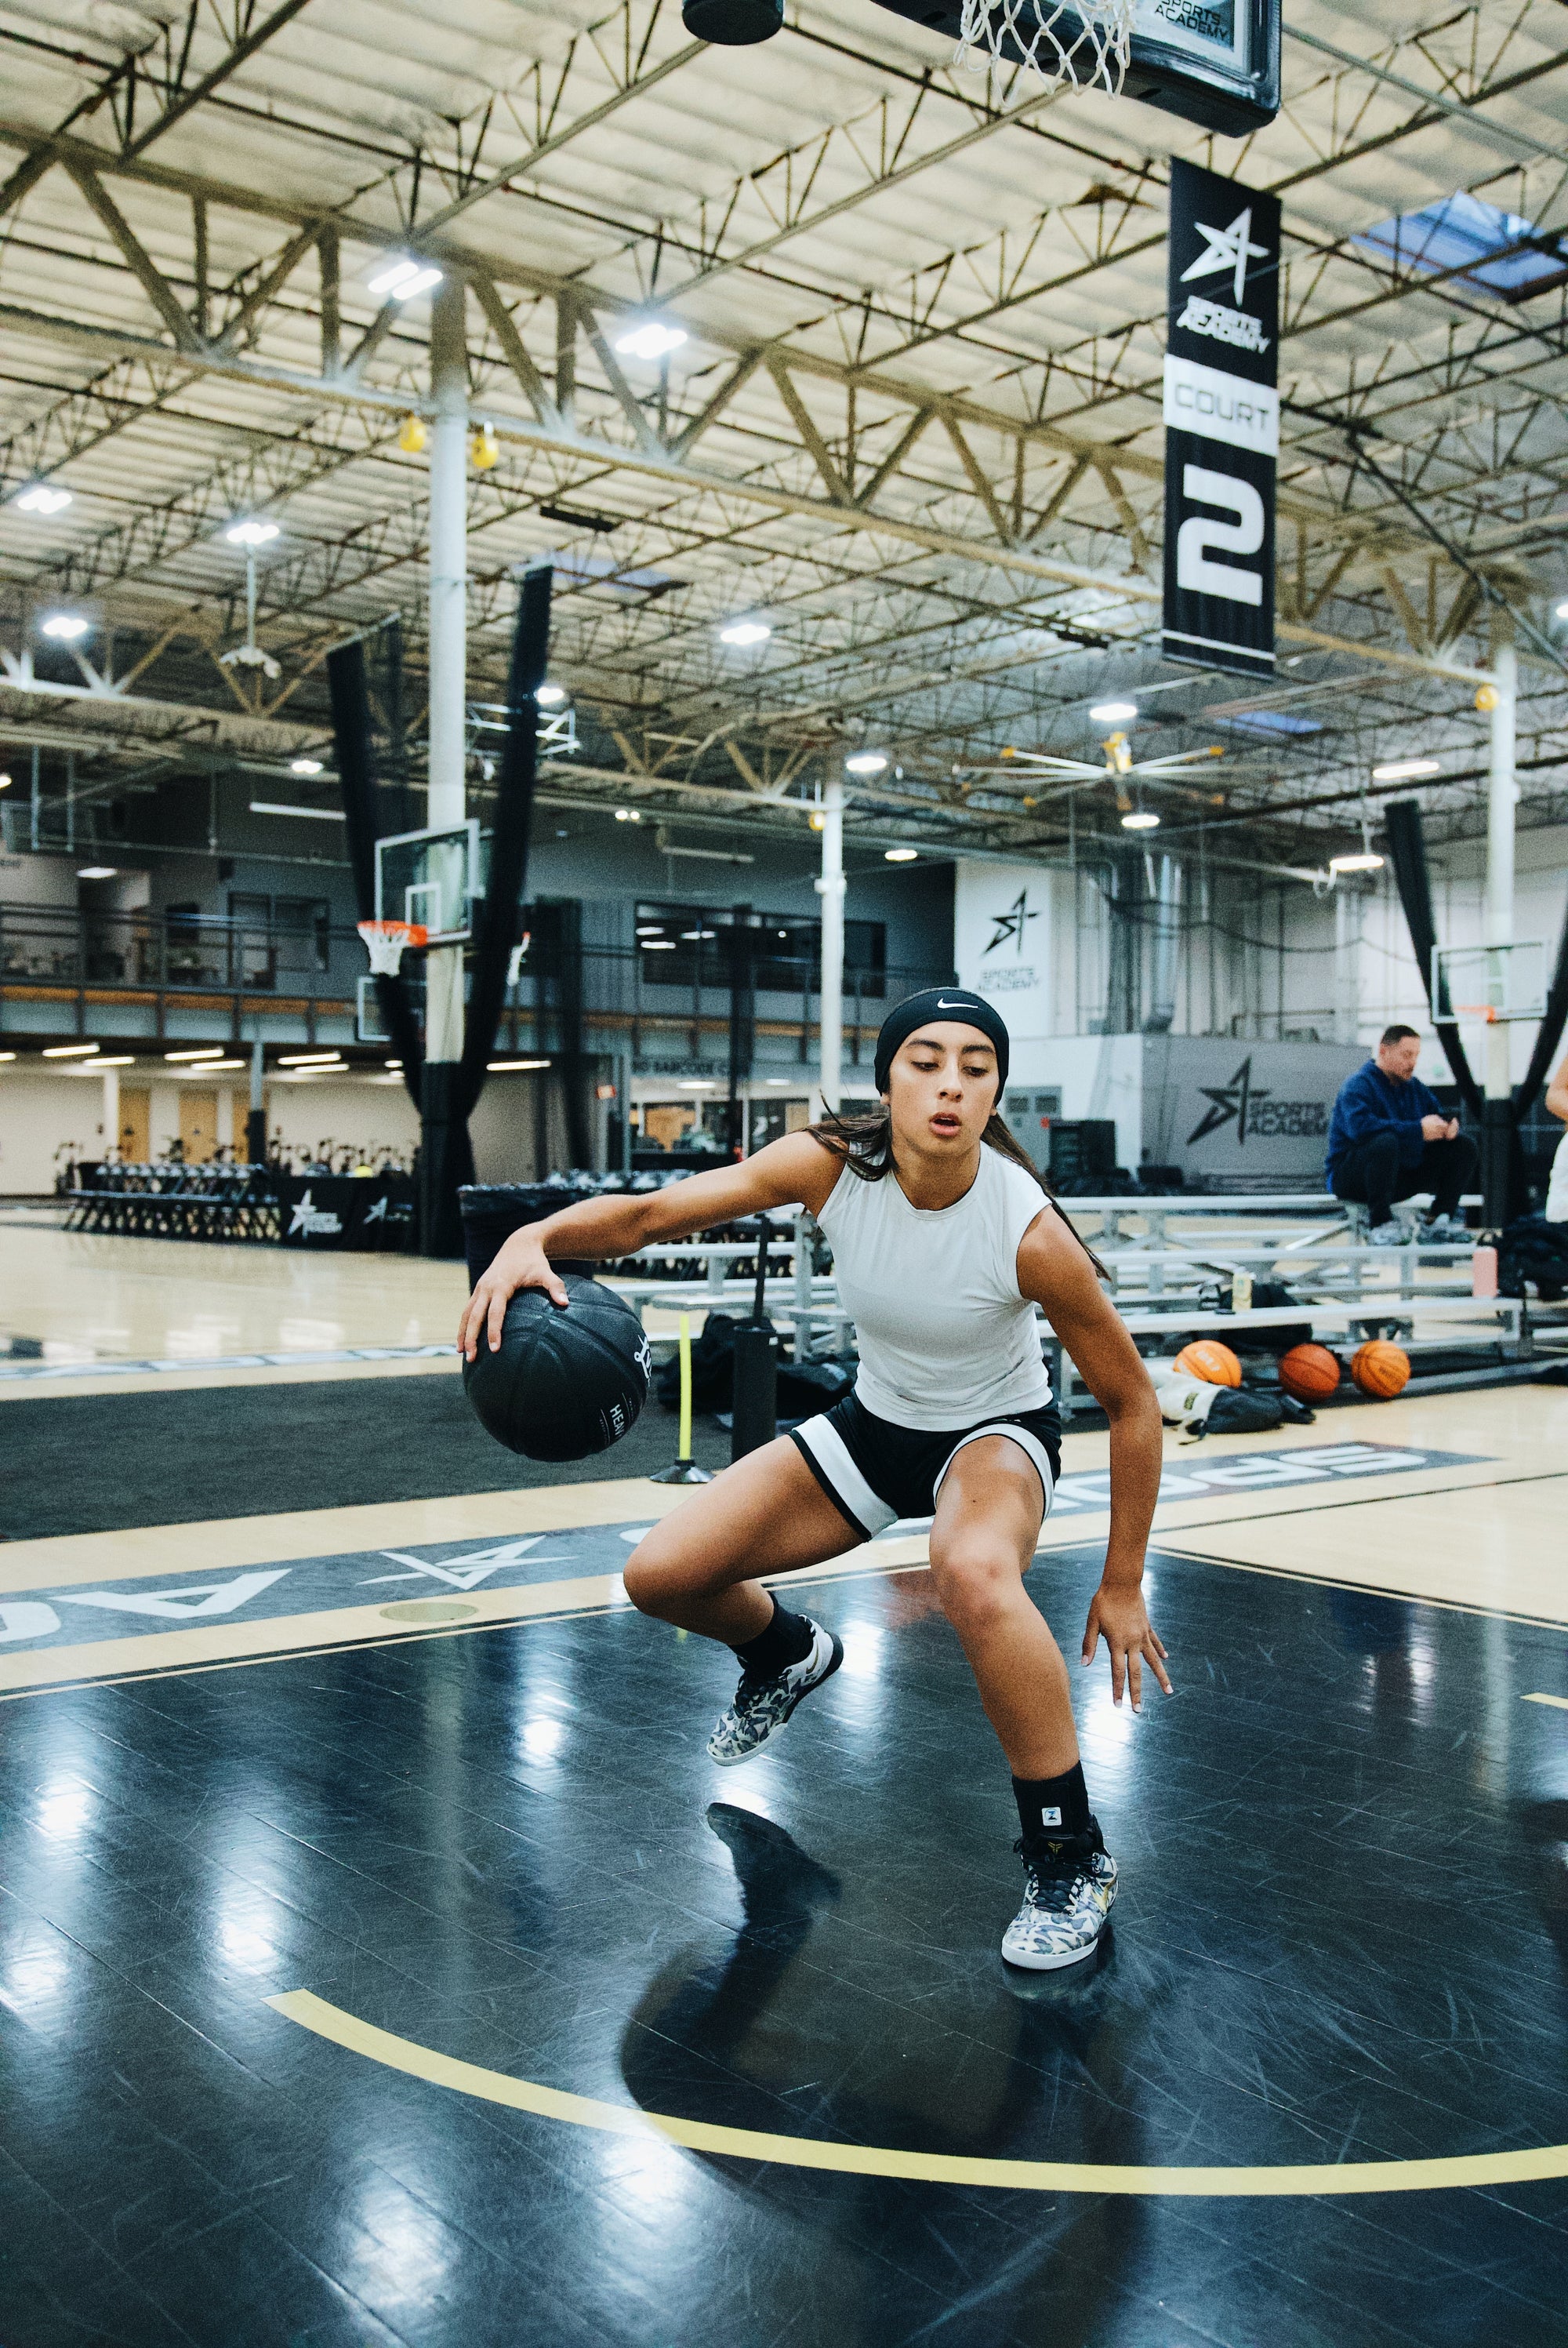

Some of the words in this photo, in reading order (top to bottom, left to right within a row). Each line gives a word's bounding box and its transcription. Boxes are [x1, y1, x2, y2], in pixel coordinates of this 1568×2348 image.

[1155, 5, 1228, 40] ACADEMY
[1177, 308, 1271, 353] ACADEMY
[1176, 384, 1269, 430] COURT
[1178, 463, 1265, 606] 2
[1247, 1118, 1329, 1136] ACADEM
[1250, 1102, 1326, 1119] SPORTS
[609, 1404, 626, 1438] HEAV
